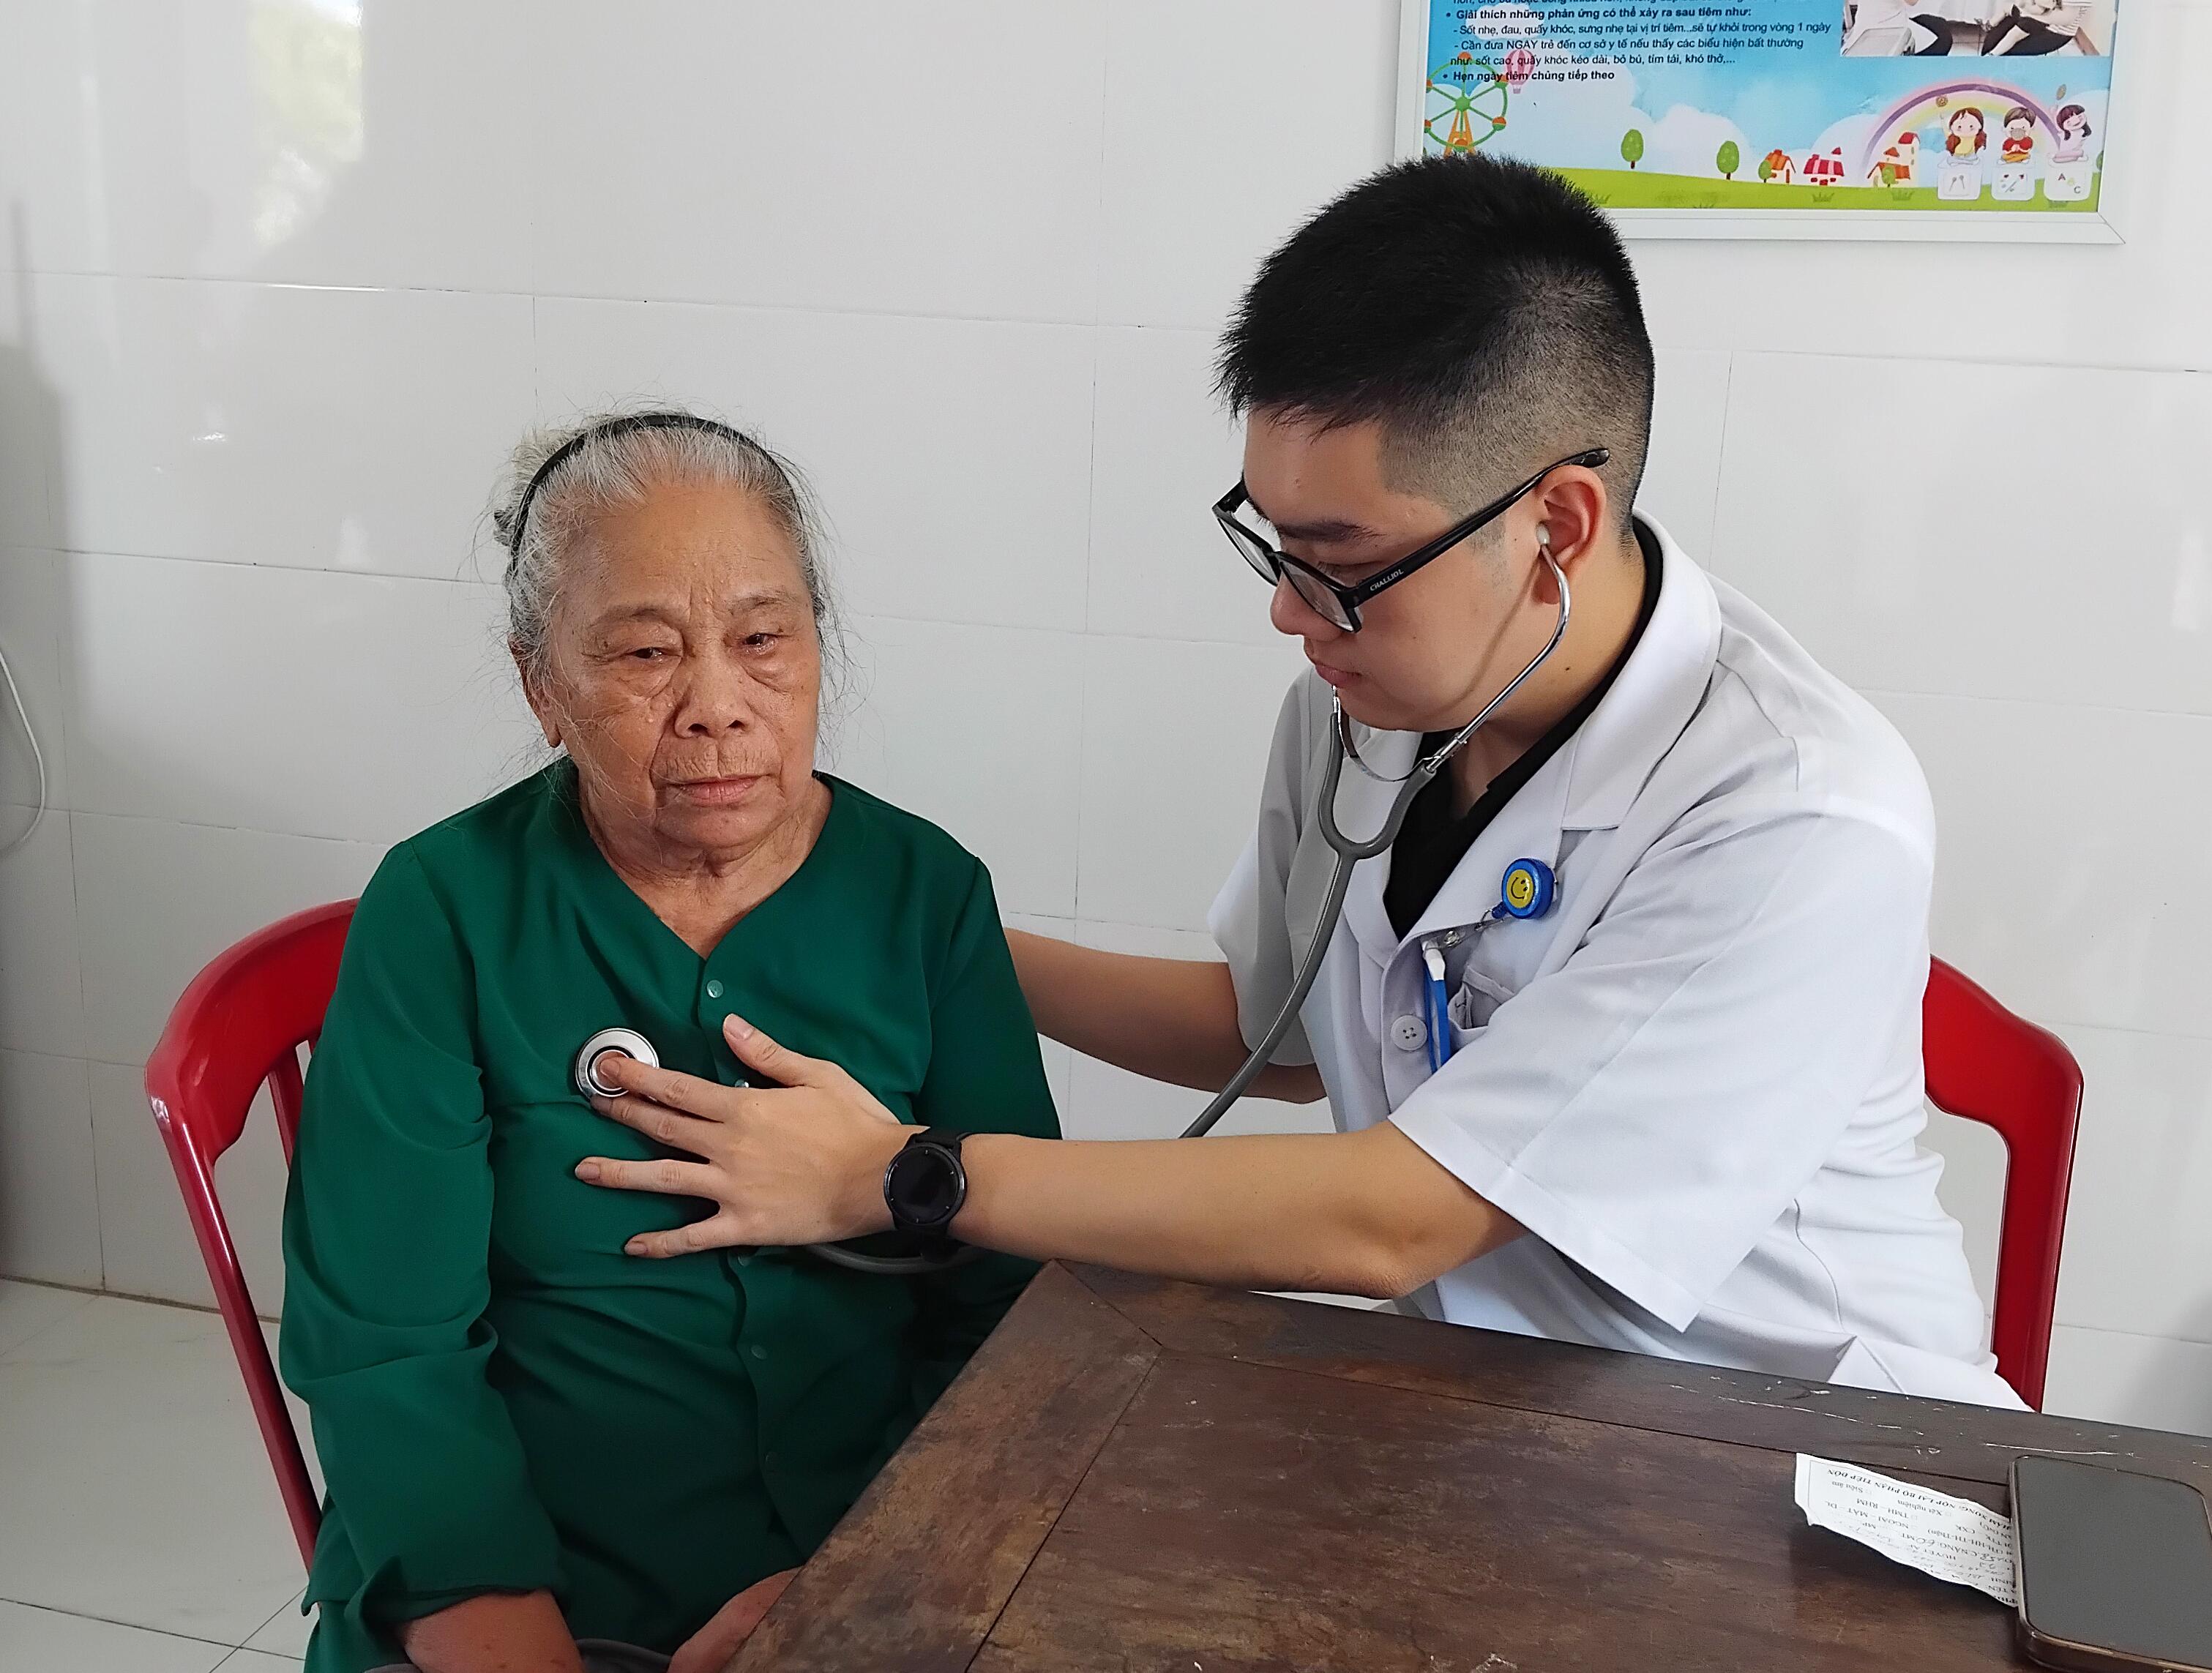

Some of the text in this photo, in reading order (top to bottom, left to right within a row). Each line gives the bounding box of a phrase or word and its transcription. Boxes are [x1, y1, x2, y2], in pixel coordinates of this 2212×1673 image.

[1456, 6, 1751, 20] Giải thích những phản ứng có thể xảy ra sau tiêm như:
[1460, 24, 1476, 34] Sốt
[1478, 26, 1498, 37] nhẹ,
[1501, 25, 1522, 35] đau,
[1550, 24, 1575, 34] khóc,
[1578, 25, 1603, 35] sưng
[1605, 24, 1623, 35] nhẹ
[1626, 23, 1638, 35] tại
[1640, 23, 1648, 35] vị
[1651, 23, 1661, 32] trí
[1706, 23, 1717, 34] tự
[1719, 22, 1739, 31] khỏi
[1742, 23, 1768, 34] trong
[1770, 22, 1795, 34] vòng
[1798, 22, 1803, 31] 1
[1806, 22, 1831, 34] ngày
[1461, 40, 1481, 50] Cần
[1484, 40, 1503, 50] đưa
[1506, 40, 1538, 50] NGAY
[1541, 40, 1554, 49] trẻ
[1557, 38, 1576, 49] đến
[1578, 40, 1591, 49] cơ
[1593, 39, 1606, 48] sở
[1608, 41, 1615, 50] y
[1618, 38, 1628, 48] tế
[1630, 38, 1649, 48] nếu
[1652, 37, 1674, 50] thấy
[1677, 39, 1695, 48] các
[1722, 38, 1744, 50] hiện
[1747, 37, 1764, 48] bất
[1475, 55, 1491, 65] sốt
[1493, 58, 1514, 66] cao,
[1544, 55, 1568, 64] khóc
[1571, 55, 1589, 64] kéo
[1613, 55, 1626, 64] bỏ
[1629, 54, 1645, 64] bú,
[1648, 54, 1664, 64] tím
[1685, 54, 1704, 64] khó
[1453, 72, 1473, 82] Hẹn
[1477, 72, 1501, 82] ngày
[1506, 71, 1528, 80] tiêm
[1568, 69, 1588, 81] tiếp
[1591, 70, 1615, 79] theo
